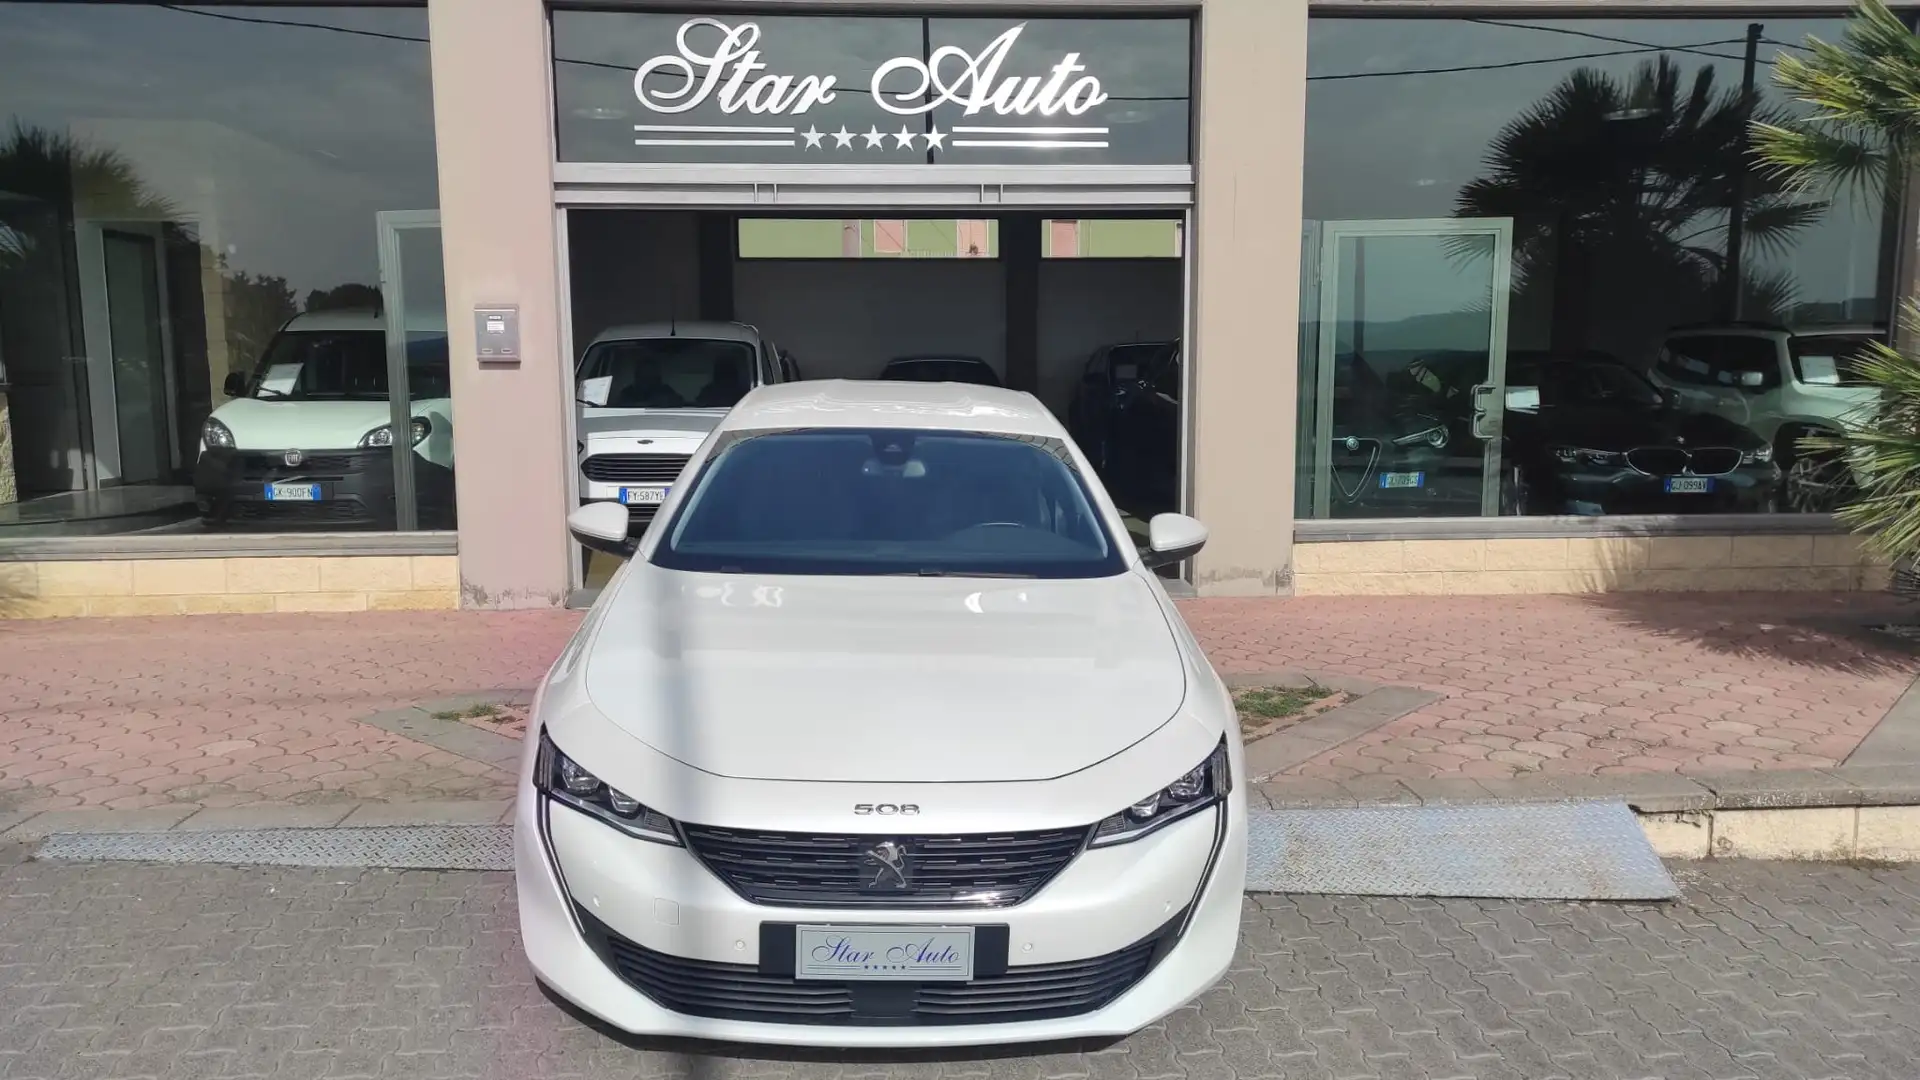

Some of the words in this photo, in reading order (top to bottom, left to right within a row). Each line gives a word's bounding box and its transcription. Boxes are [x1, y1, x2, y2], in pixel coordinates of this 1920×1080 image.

[634, 17, 836, 115] Star
[871, 21, 1108, 117] Auto
[854, 804, 920, 815] 508
[812, 935, 875, 963] Star
[886, 937, 960, 963] Auto
